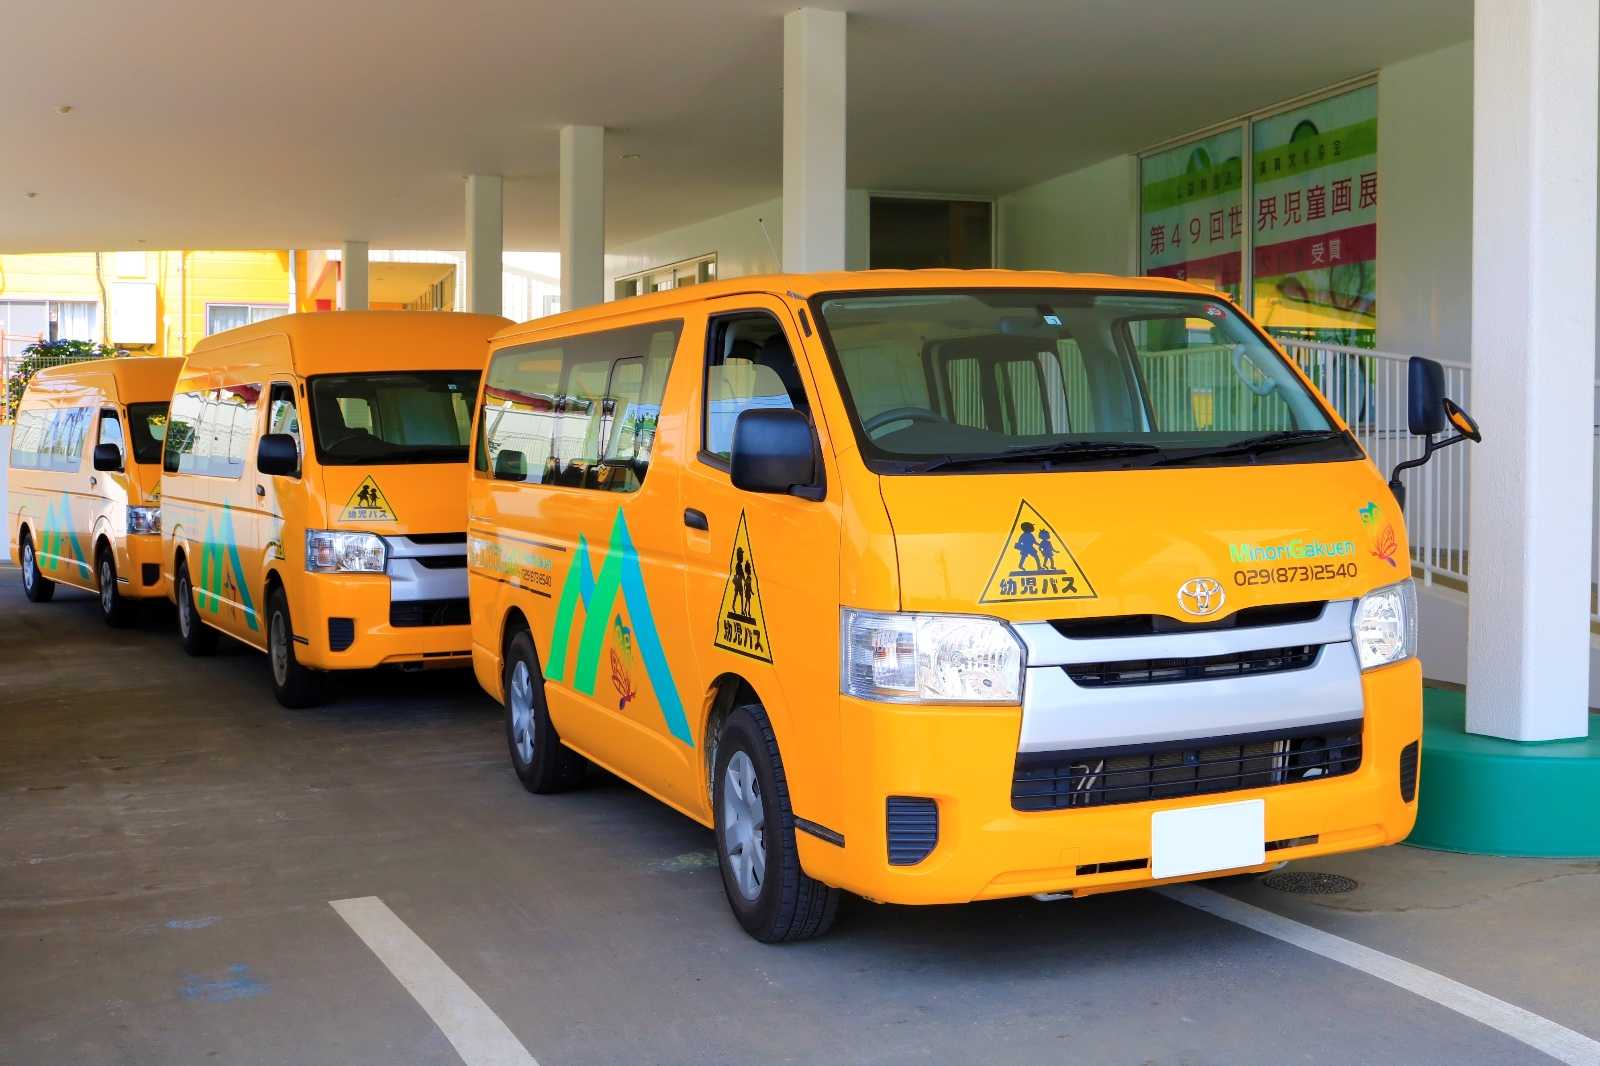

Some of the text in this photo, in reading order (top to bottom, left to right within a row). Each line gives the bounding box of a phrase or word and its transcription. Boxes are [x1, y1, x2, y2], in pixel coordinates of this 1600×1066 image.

[348, 509, 387, 519] 幼児バス
[1229, 540, 1355, 562] MinoriGakuen
[1000, 576, 1078, 595] 幼児バス
[1234, 563, 1358, 586] 029(873)2540
[723, 619, 764, 653] 幼児バス
